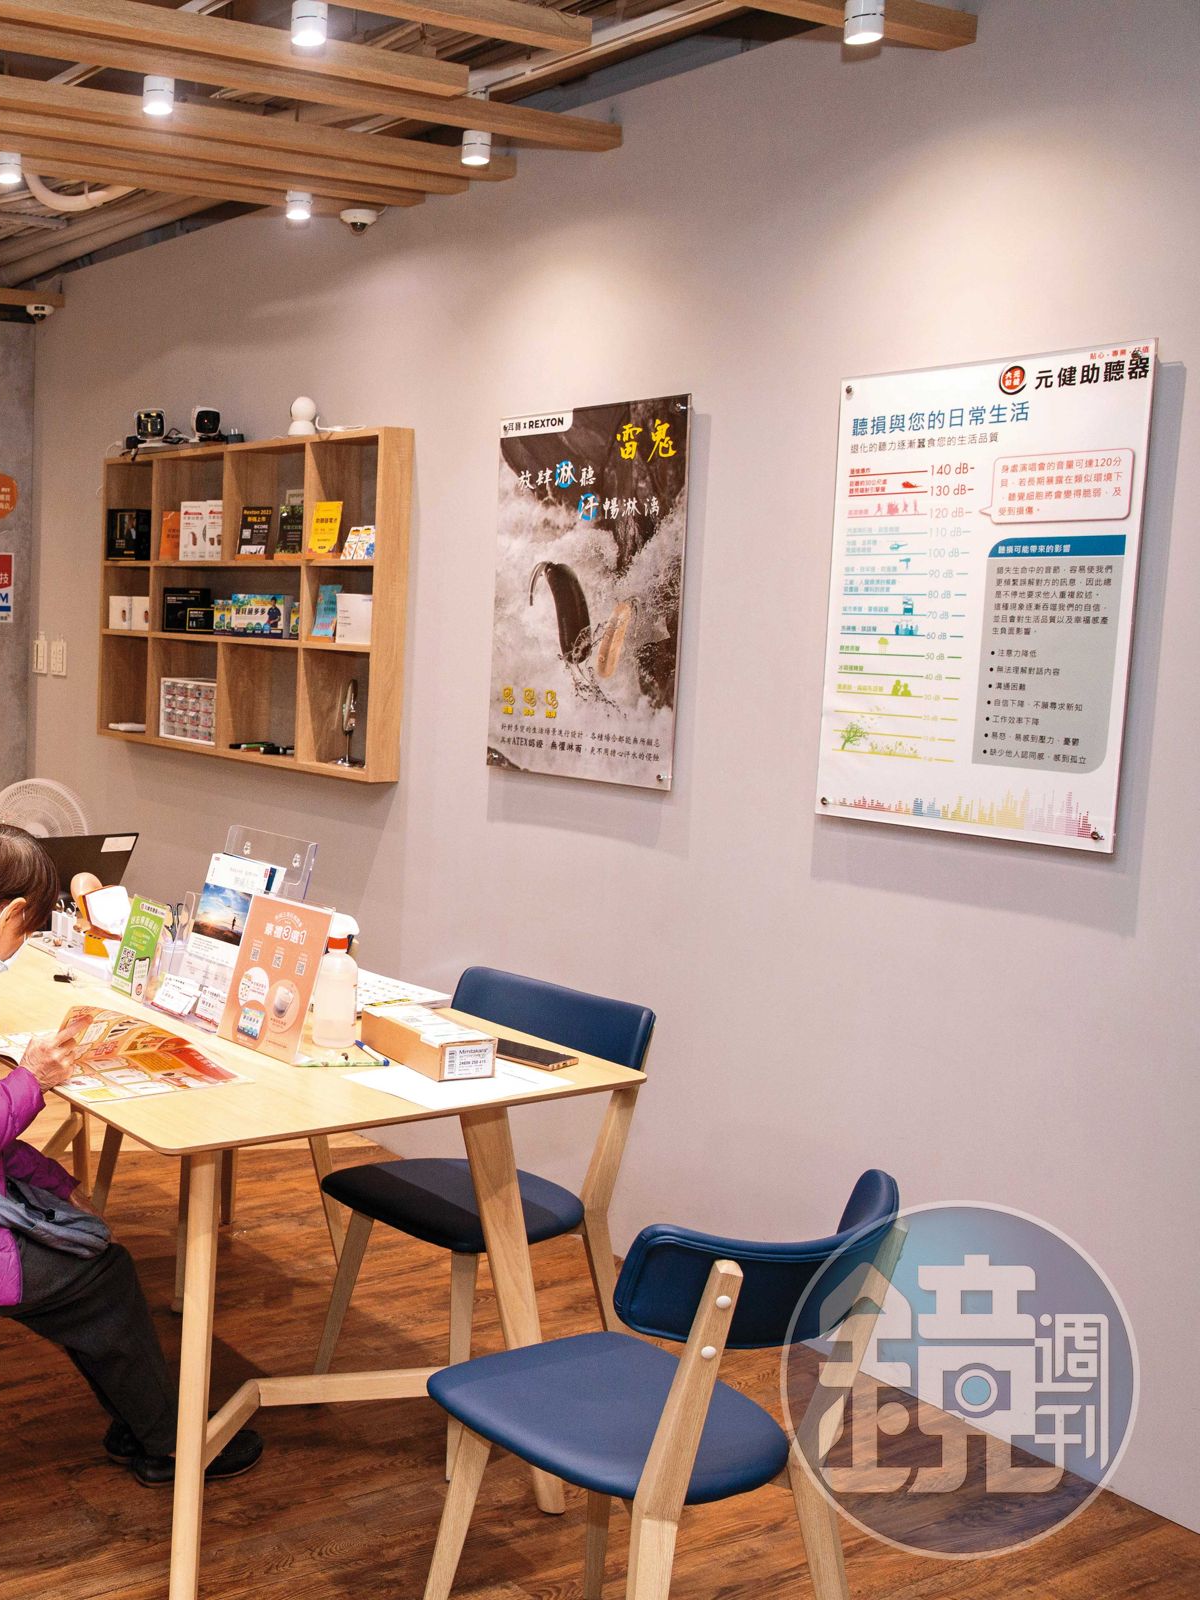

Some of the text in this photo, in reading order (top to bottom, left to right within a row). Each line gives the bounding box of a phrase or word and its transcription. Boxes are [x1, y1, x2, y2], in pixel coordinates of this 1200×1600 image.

[1035, 357, 1149, 389] 元健助聽器
[529, 417, 564, 429] REXTON
[852, 401, 1030, 437] 聽損與您的日常生活
[617, 419, 677, 463] 雷鬼
[850, 431, 999, 454] 退化的聽力逐漸蠶食您的生活品質
[518, 461, 597, 490] 放肆淋聽
[931, 464, 951, 476] 140
[930, 485, 950, 496] 130
[930, 508, 948, 519] 120
[929, 527, 947, 537] 110
[929, 548, 946, 558] 100
[929, 570, 940, 578] 90
[928, 591, 938, 599] 80
[998, 649, 1037, 658] 注意力降低
